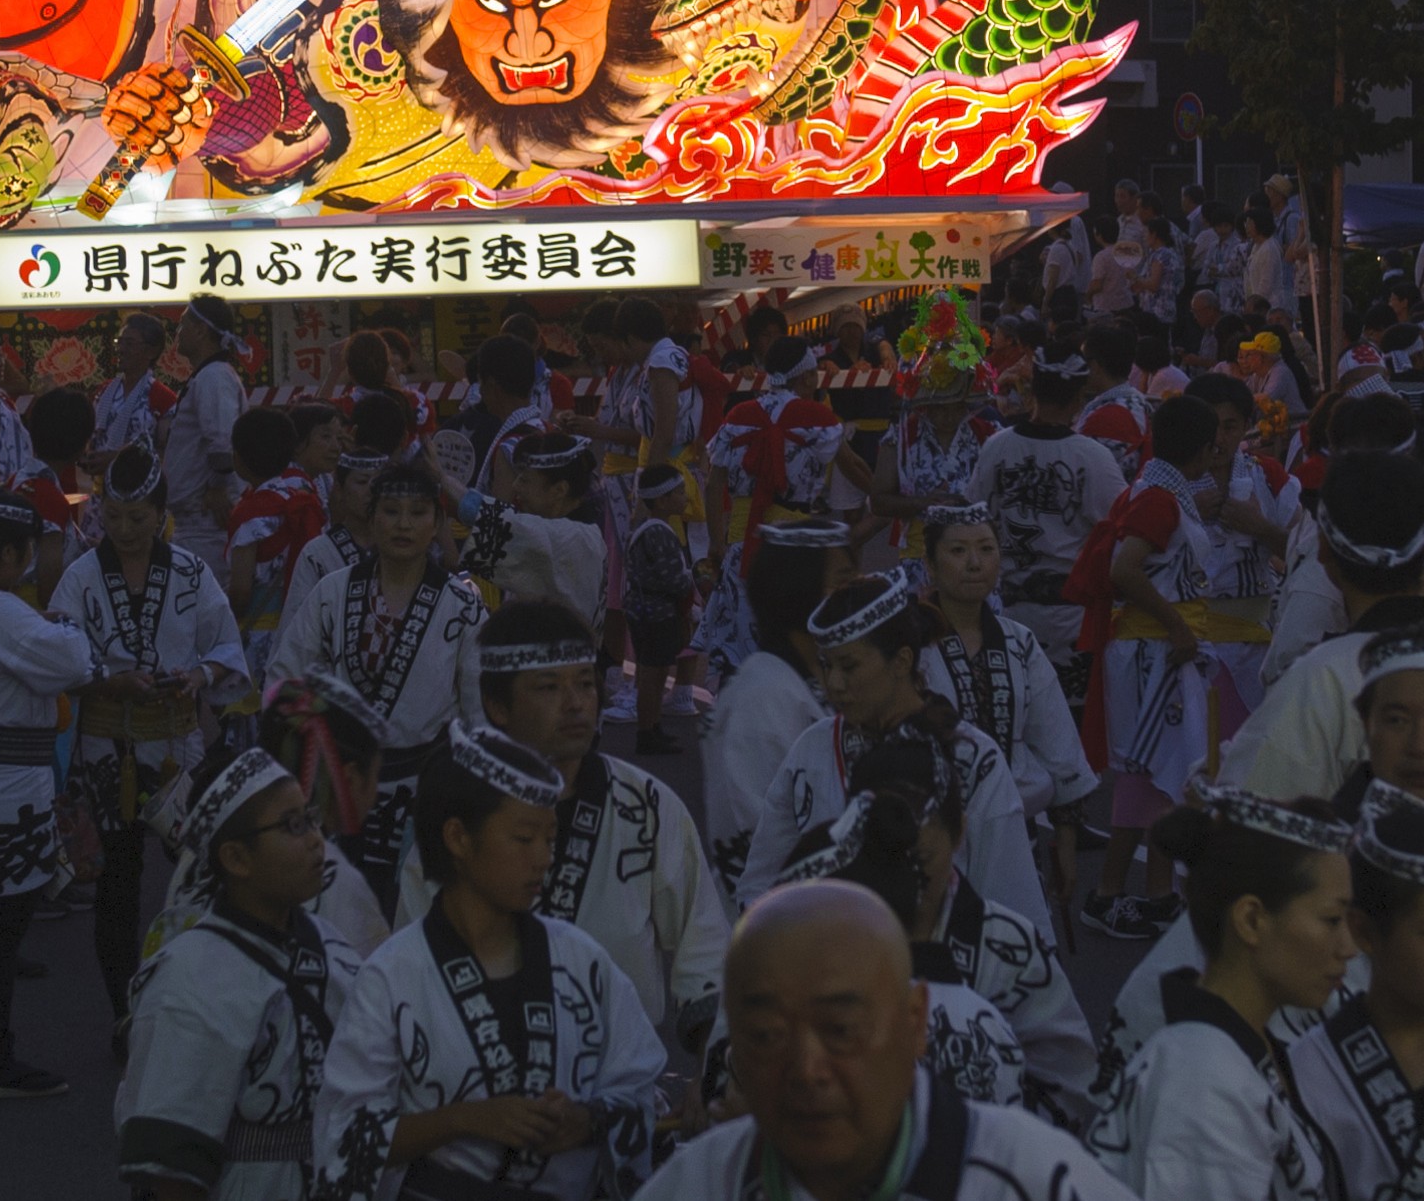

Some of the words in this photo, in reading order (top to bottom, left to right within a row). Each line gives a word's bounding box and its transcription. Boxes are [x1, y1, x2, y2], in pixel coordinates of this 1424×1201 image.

[82, 229, 638, 293] 県庁ねぶた実行委員会
[294, 304, 326, 381] 許可
